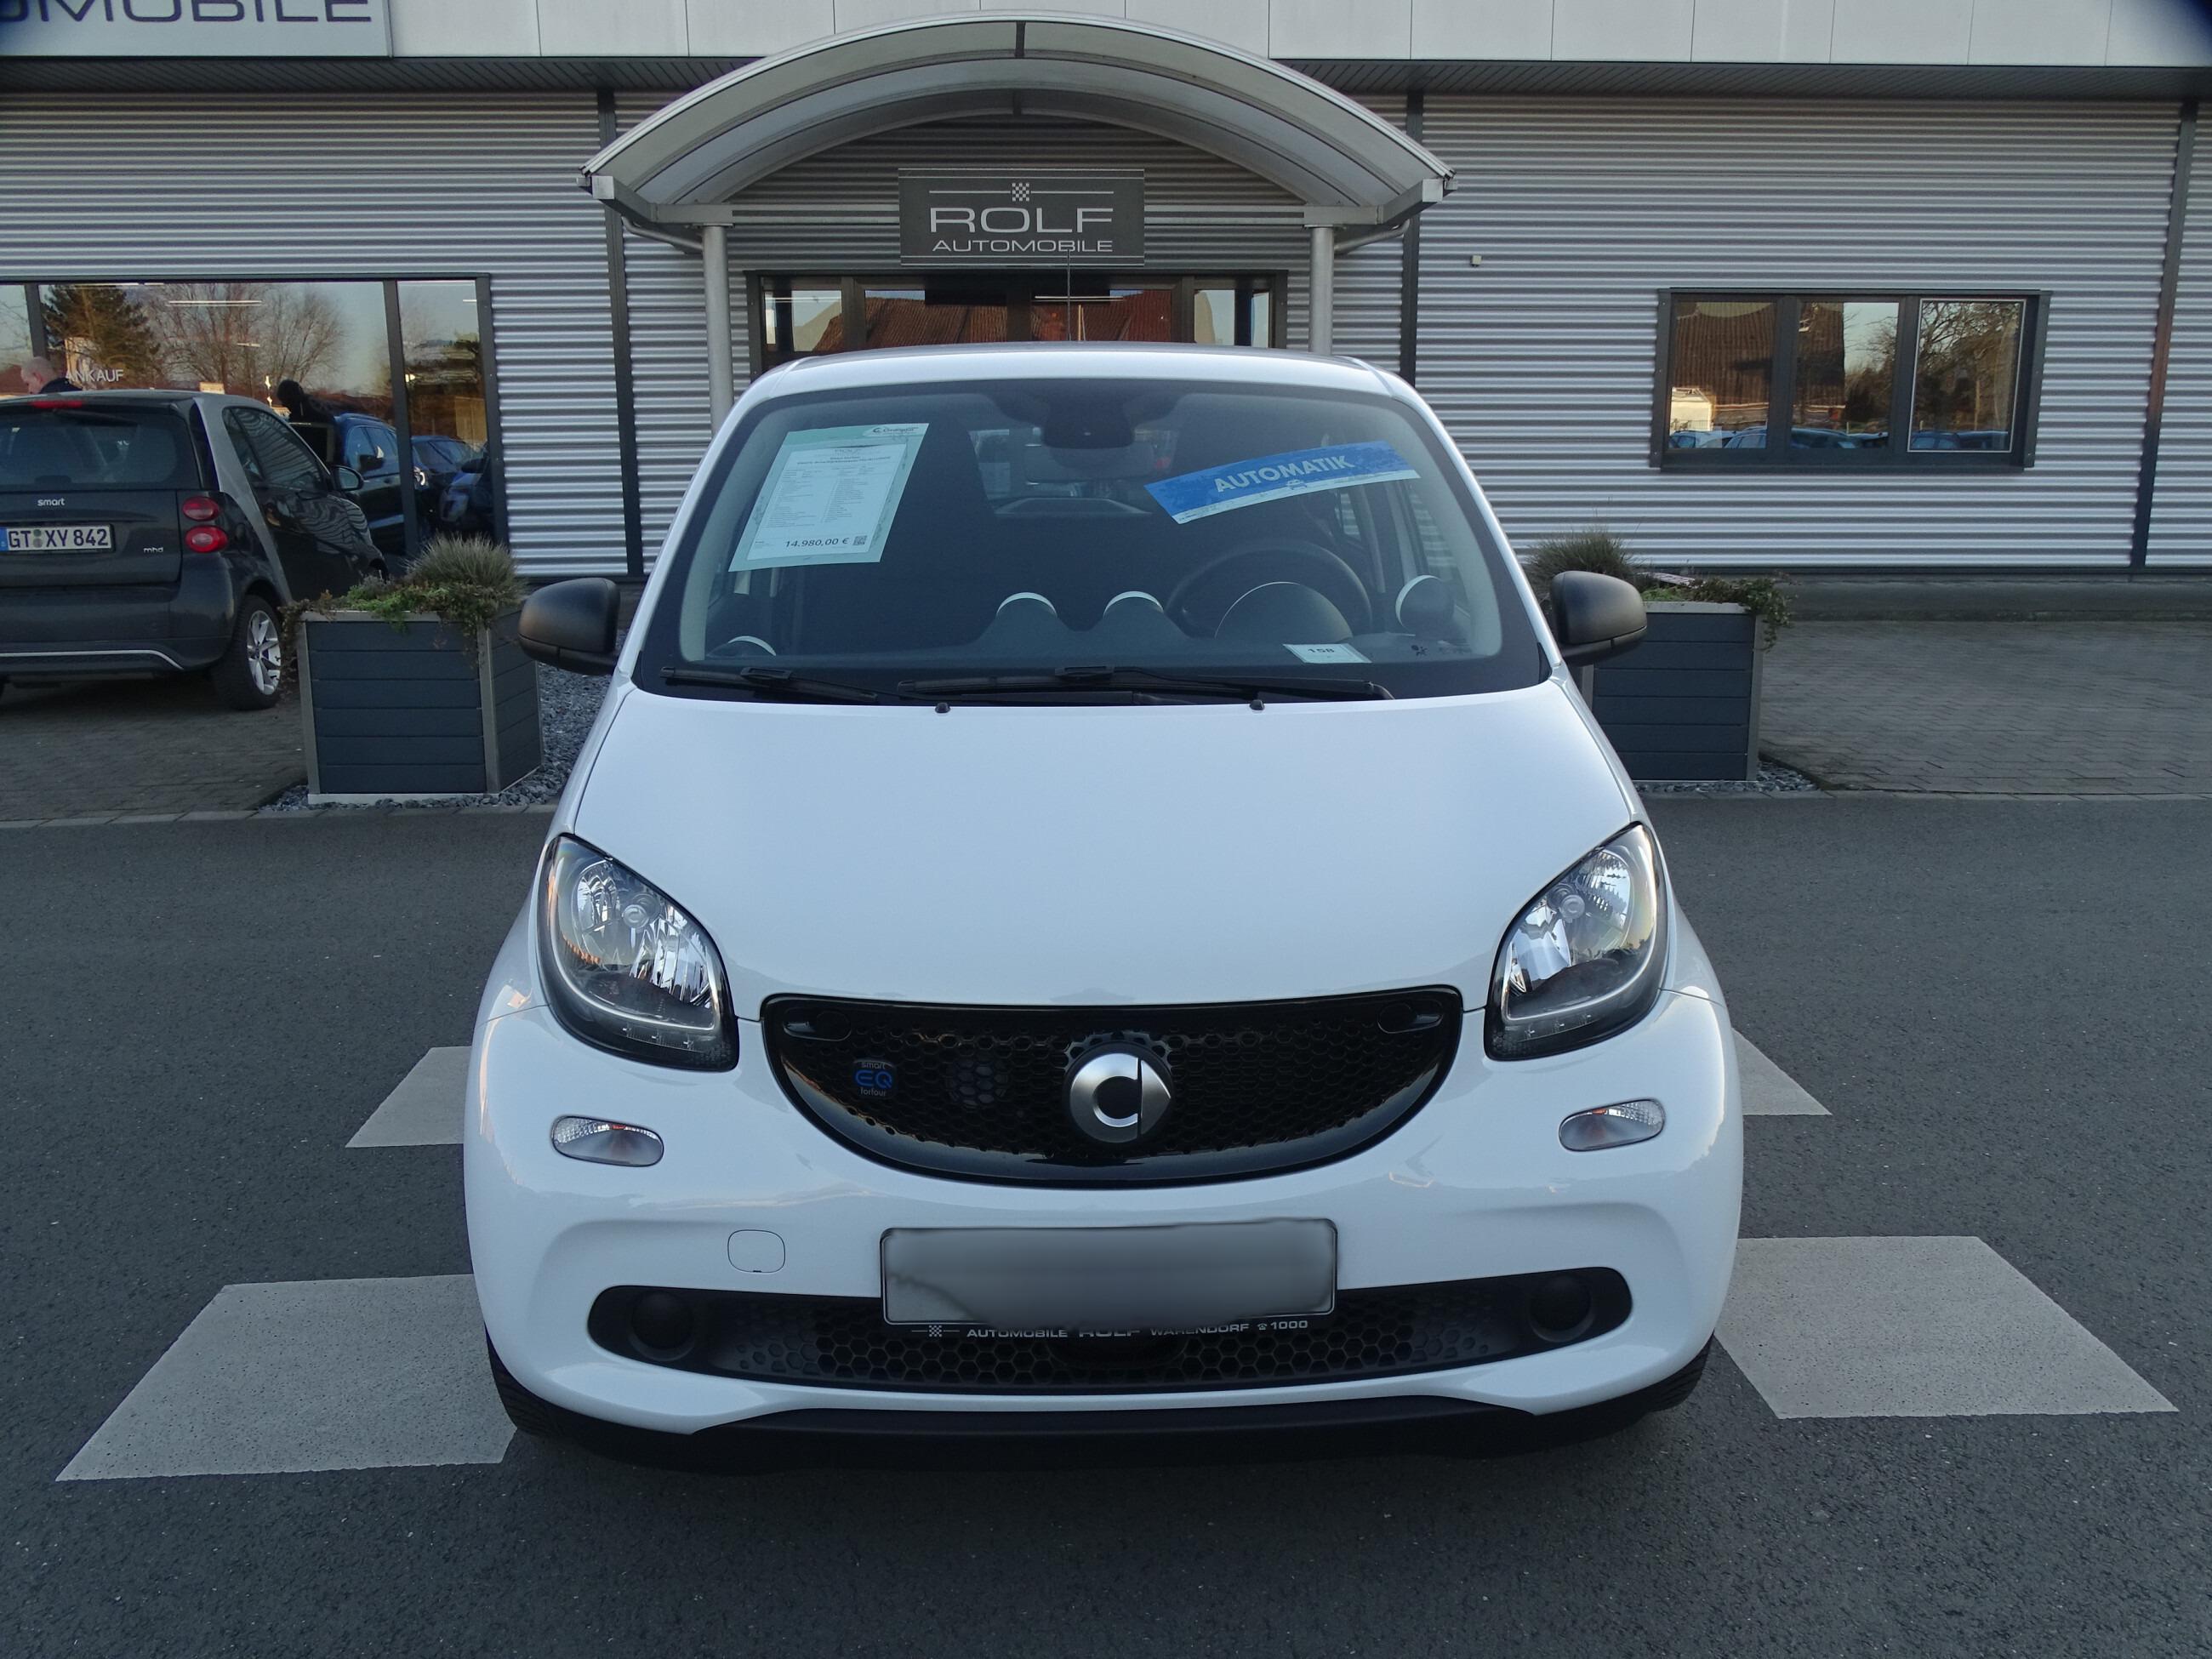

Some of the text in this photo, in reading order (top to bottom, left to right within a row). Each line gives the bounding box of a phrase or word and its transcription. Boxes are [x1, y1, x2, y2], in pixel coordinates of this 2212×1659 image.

[0, 0, 372, 22] MOBILE
[929, 207, 1114, 233] ROLF
[932, 239, 1114, 253] AUTOMOBILE
[66, 368, 124, 382] ANKAUF
[1213, 455, 1355, 493] AUTOMATIK
[37, 498, 66, 506] smart
[9, 528, 109, 548] GT XY 842
[855, 1069, 892, 1089] EQ
[966, 1329, 1069, 1338] AUTOMOBILE
[1270, 1320, 1308, 1330] 1000
